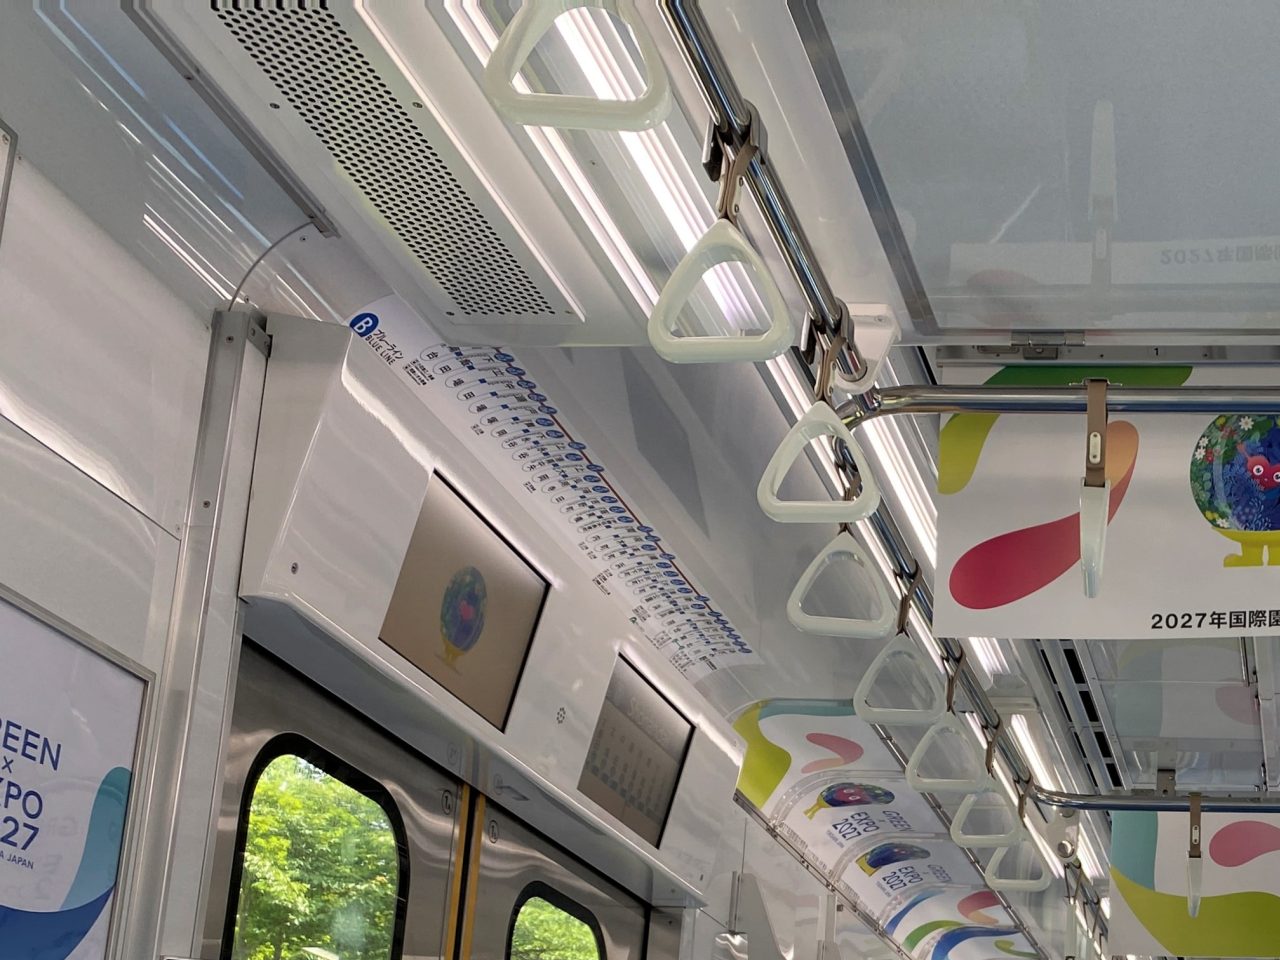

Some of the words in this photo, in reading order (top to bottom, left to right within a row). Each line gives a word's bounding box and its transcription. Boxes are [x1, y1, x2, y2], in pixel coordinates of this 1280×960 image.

[365, 334, 383, 352] BLUE
[380, 350, 396, 366] LINE
[372, 328, 404, 360] ブルーライン
[832, 818, 862, 841] 2027
[850, 811, 880, 833] EXPO
[7, 853, 34, 870] JAPAN
[882, 871, 908, 891] 2027
[898, 865, 923, 884] EXPO
